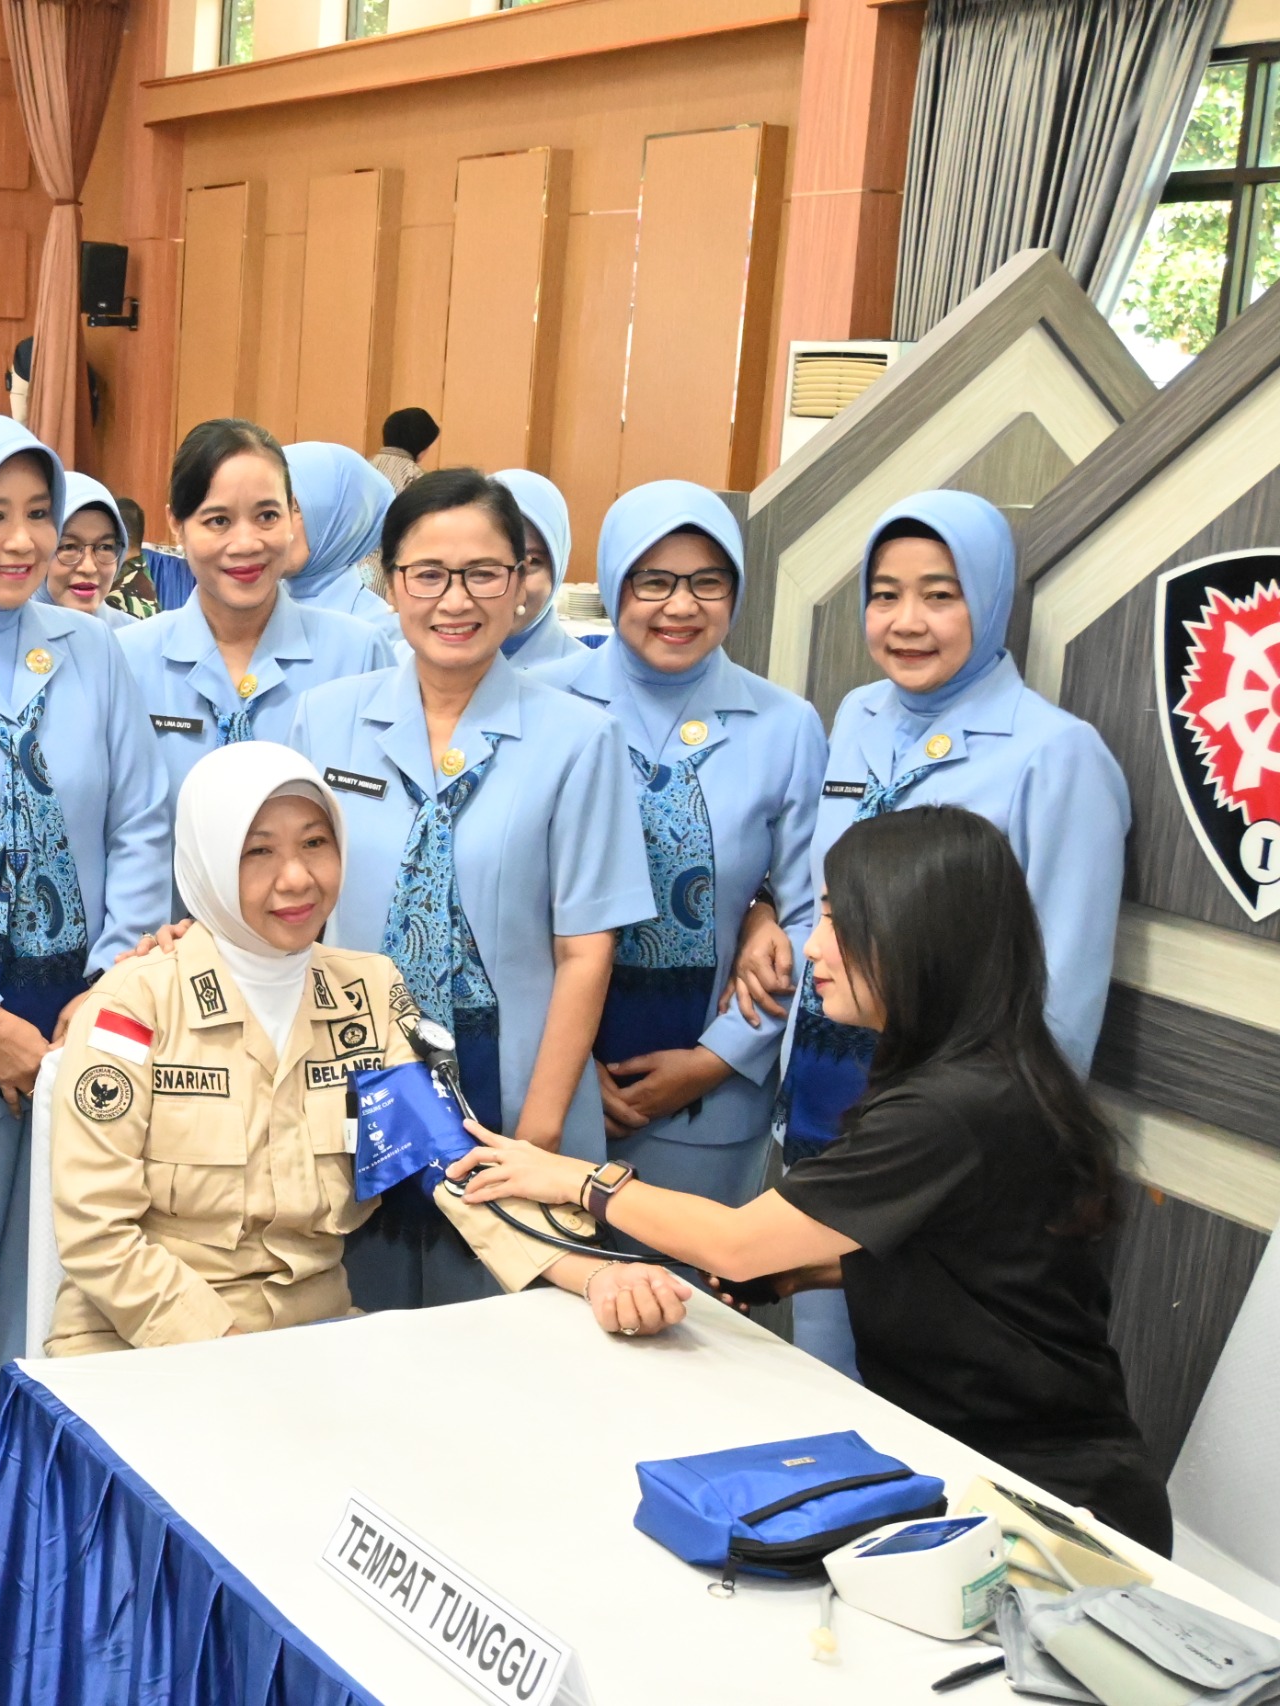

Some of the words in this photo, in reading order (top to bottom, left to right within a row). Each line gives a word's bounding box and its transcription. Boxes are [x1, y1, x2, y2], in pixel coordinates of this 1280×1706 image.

[176, 721, 191, 729] DUTO
[328, 773, 336, 781] Ny.
[338, 776, 358, 785] WANTY
[312, 1063, 350, 1084] BELA
[338, 1514, 436, 1614] TEMPAT
[429, 1582, 547, 1701] TUNGGU
